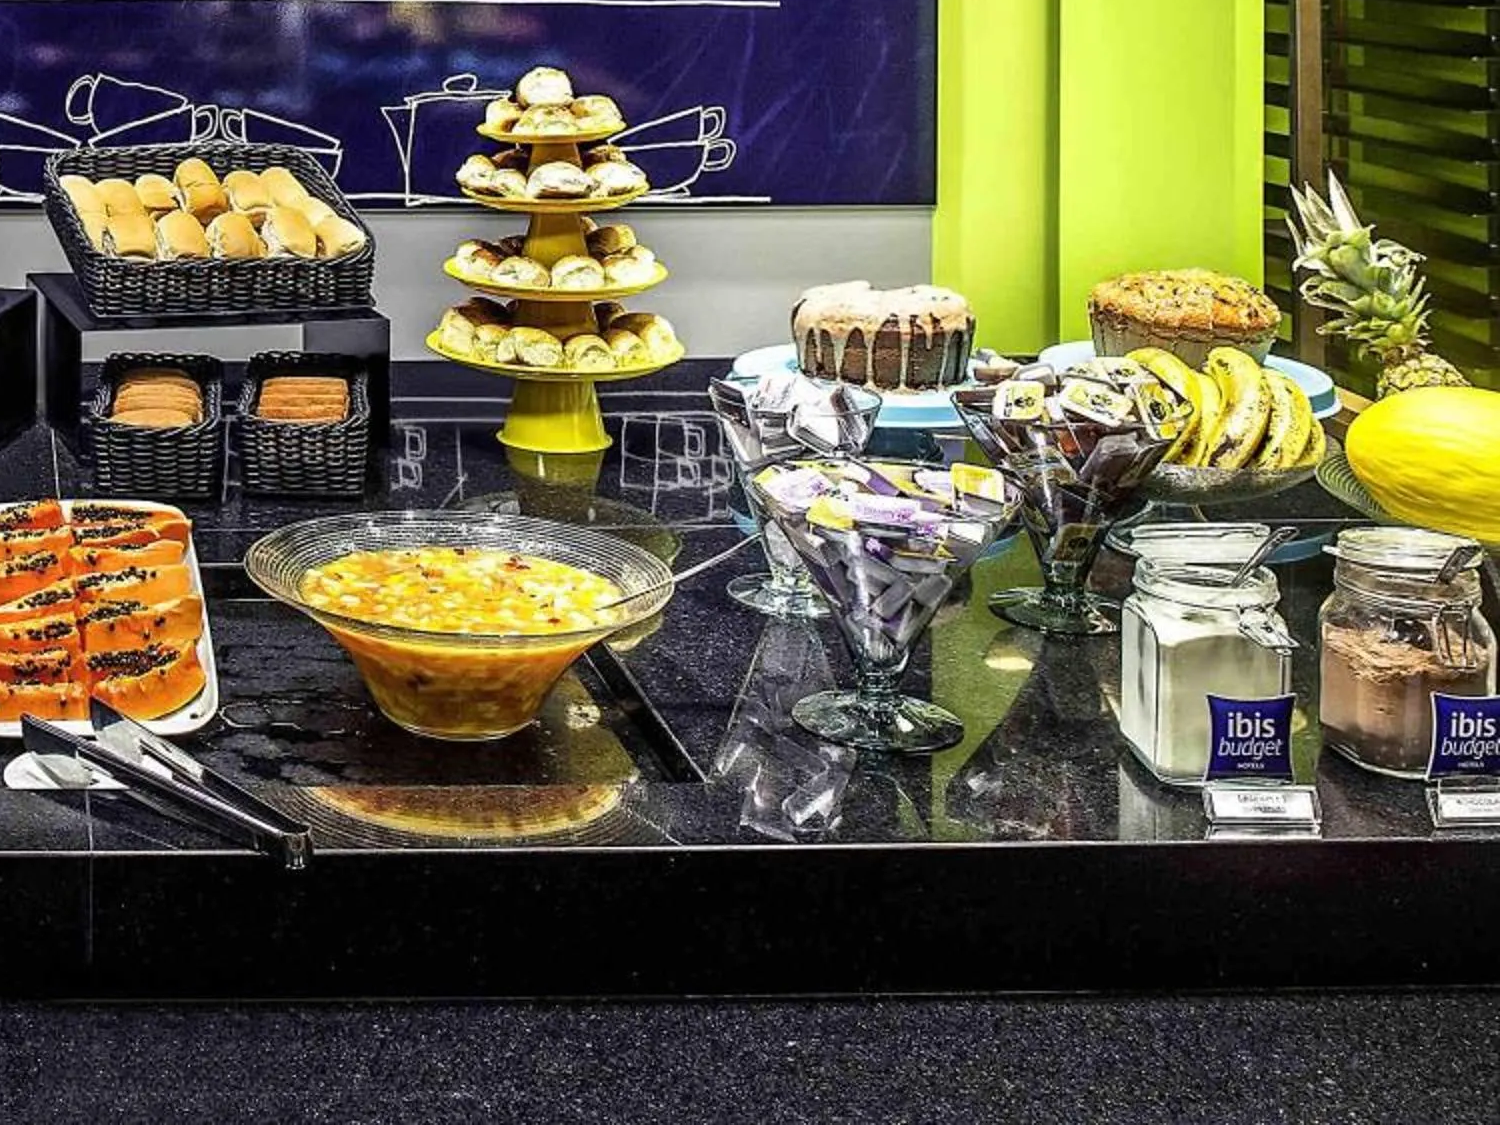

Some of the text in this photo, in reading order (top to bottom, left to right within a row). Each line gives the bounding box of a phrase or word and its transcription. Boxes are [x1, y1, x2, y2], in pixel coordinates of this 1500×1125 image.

[1227, 711, 1275, 737] ibis
[1450, 711, 1496, 737] ibis
[1218, 737, 1283, 760] budget
